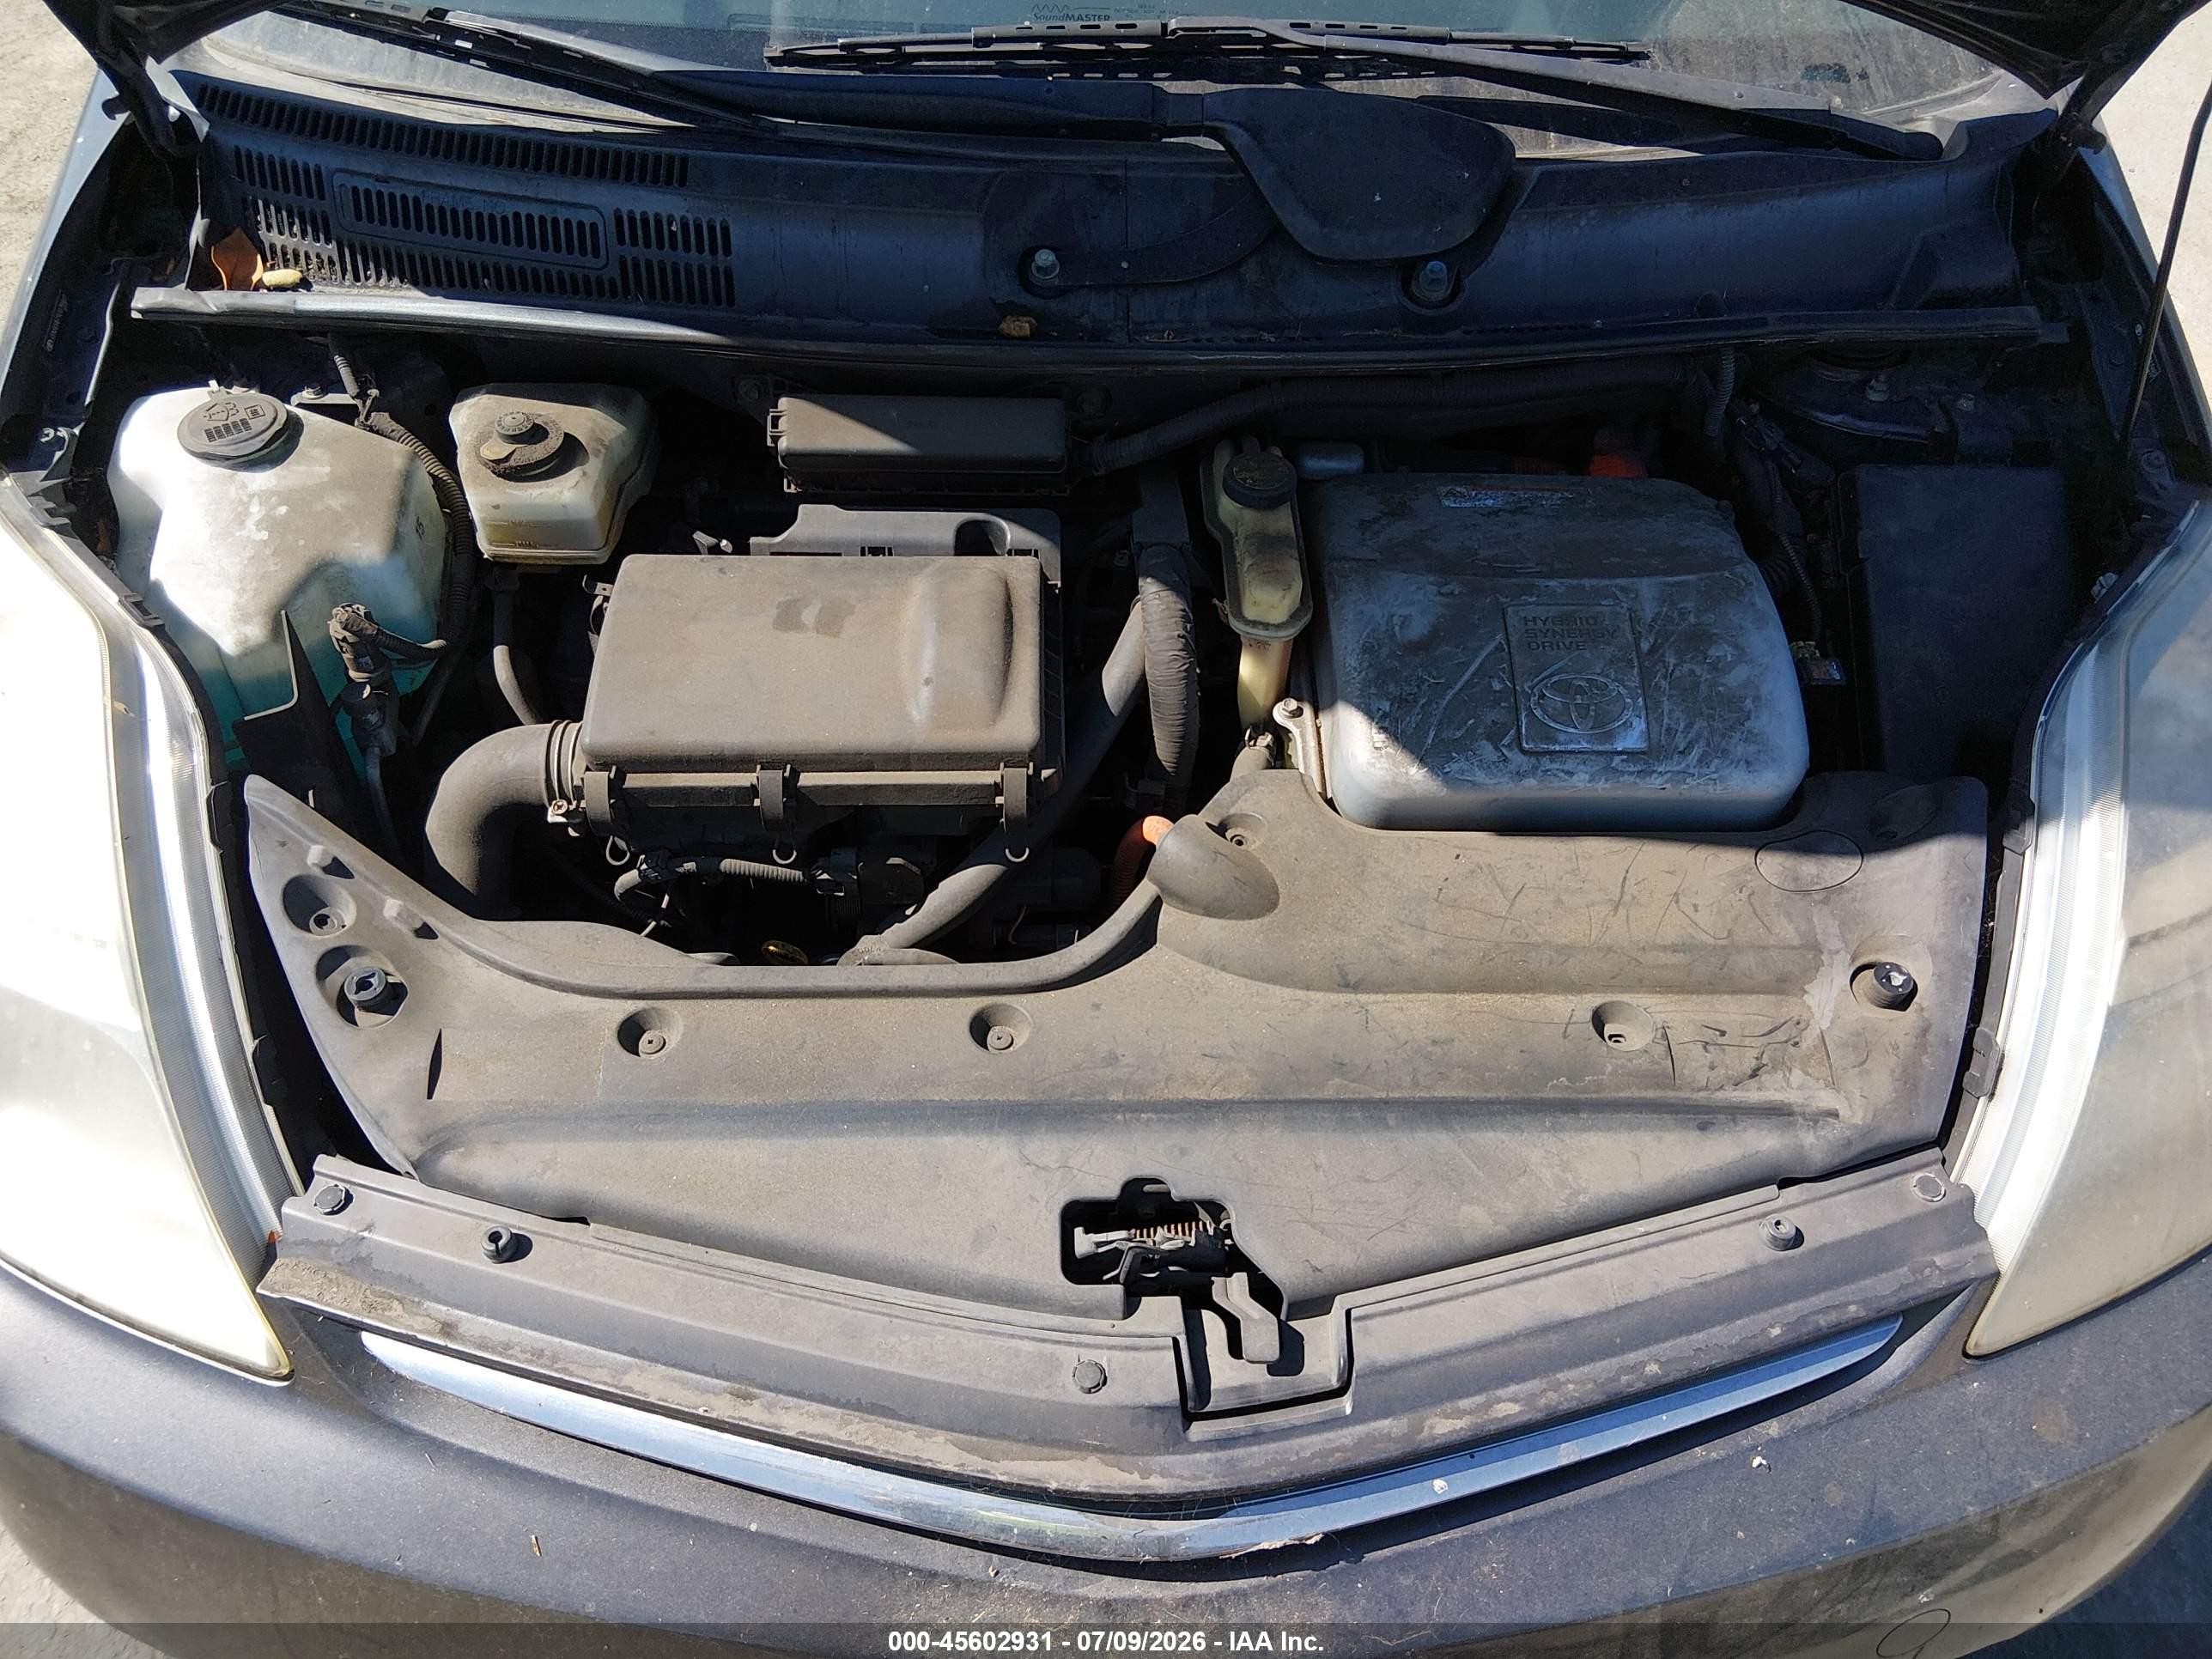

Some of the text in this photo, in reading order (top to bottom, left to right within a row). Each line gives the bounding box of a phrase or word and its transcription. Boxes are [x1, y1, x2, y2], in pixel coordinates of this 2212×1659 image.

[1033, 13, 1111, 21] SoundMASTER
[1523, 616, 1599, 626] HYBRID
[1524, 628, 1619, 639] SYNERGY
[1528, 641, 1588, 651] DRIVE
